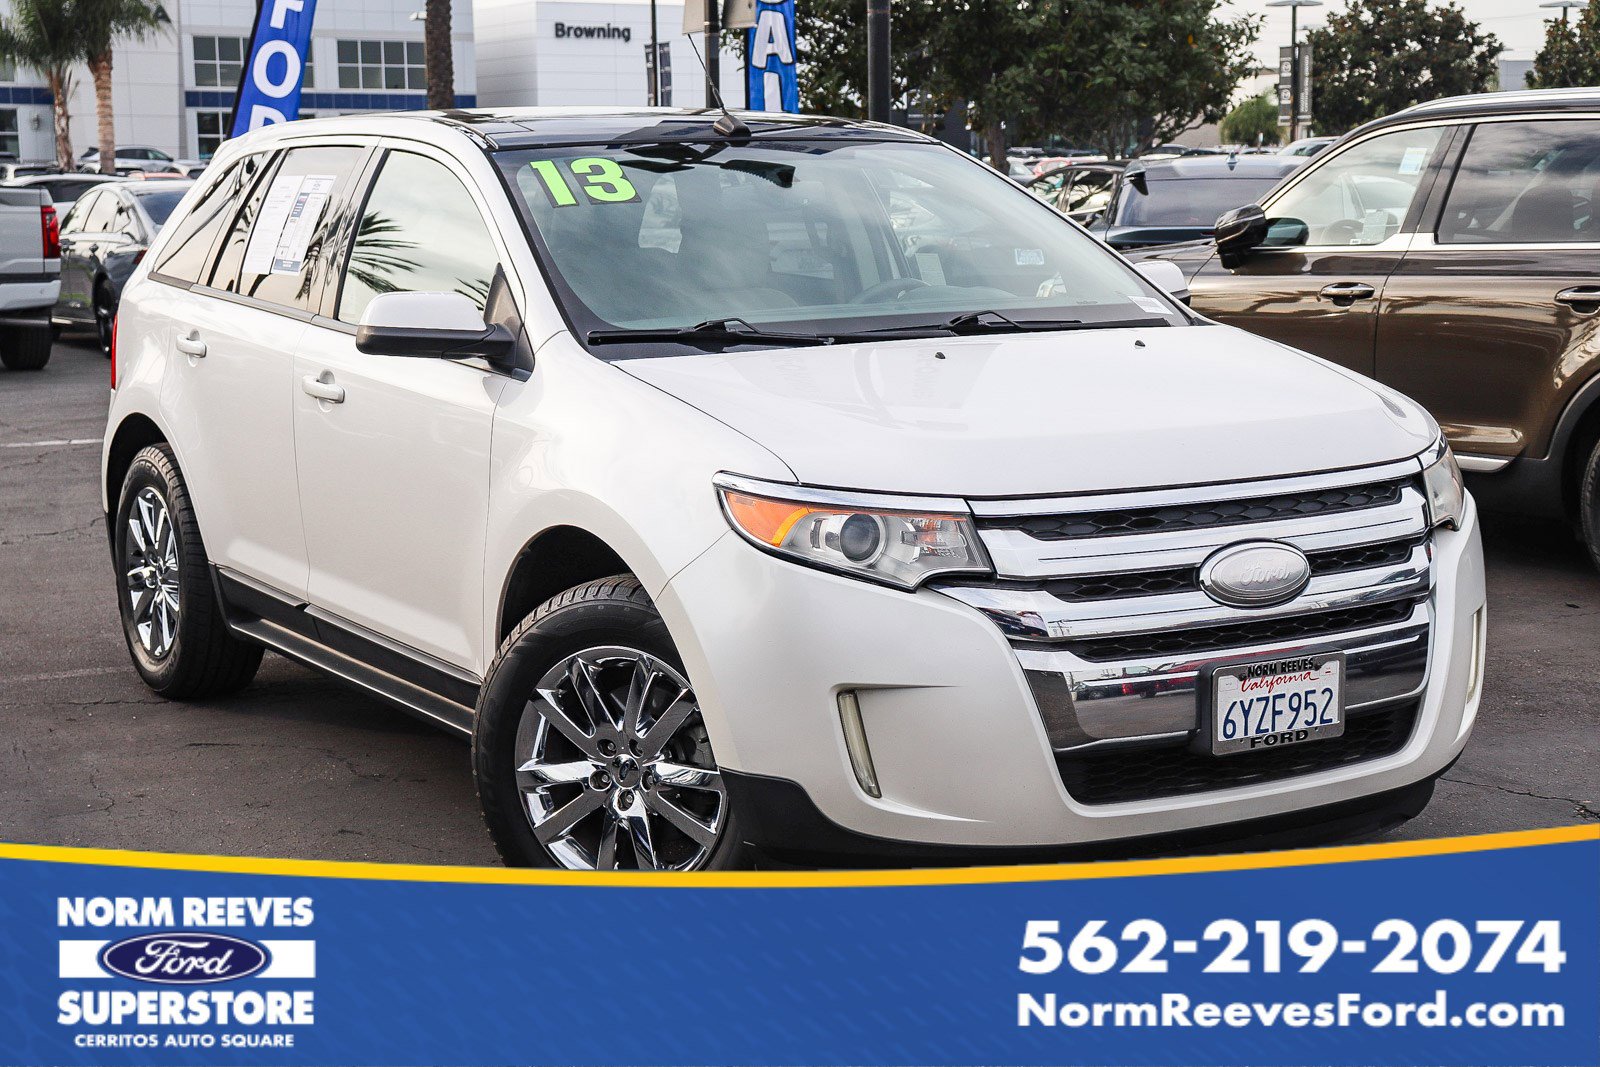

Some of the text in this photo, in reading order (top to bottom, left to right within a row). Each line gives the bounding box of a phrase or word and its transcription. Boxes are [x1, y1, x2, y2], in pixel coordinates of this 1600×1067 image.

[554, 22, 631, 42] Browning
[529, 157, 636, 206] 13
[1240, 555, 1291, 586] Ford
[1248, 663, 1278, 679] NORM
[1280, 657, 1315, 674] REEVES
[1240, 670, 1320, 694] California
[1222, 687, 1334, 740] 6YZF952
[1250, 729, 1309, 749] FORD
